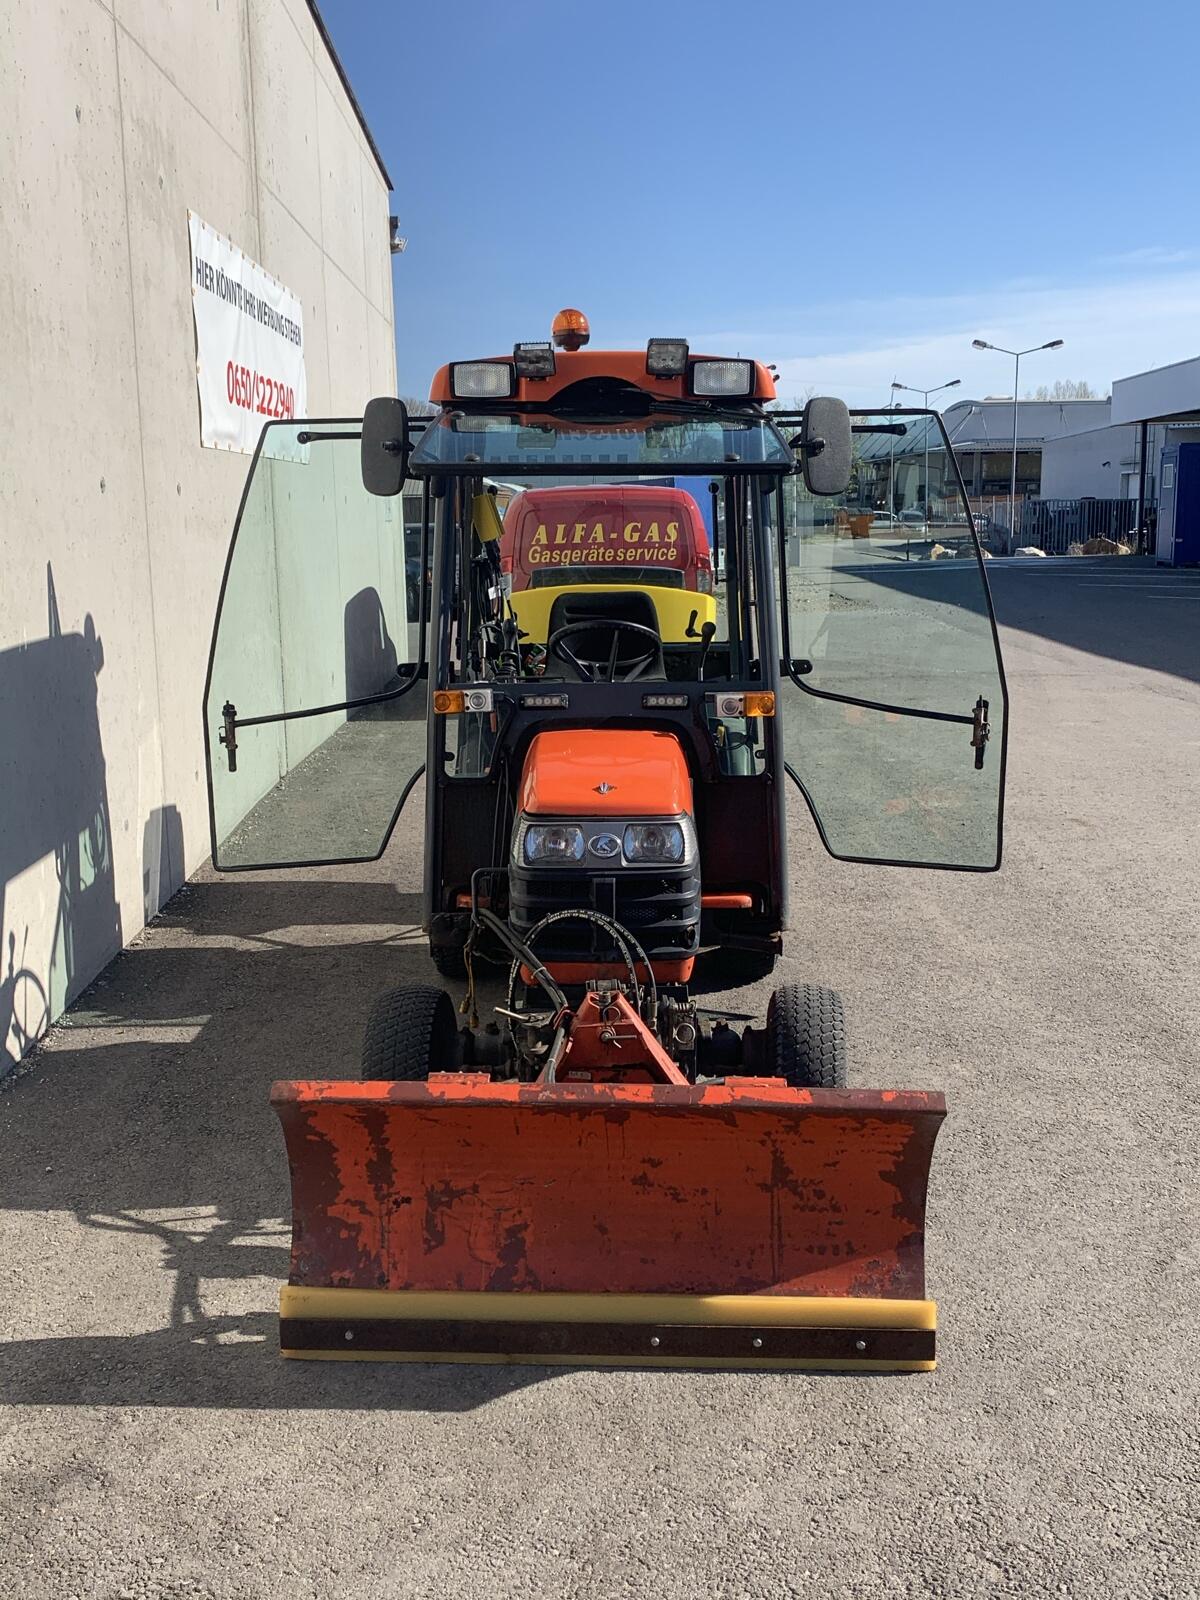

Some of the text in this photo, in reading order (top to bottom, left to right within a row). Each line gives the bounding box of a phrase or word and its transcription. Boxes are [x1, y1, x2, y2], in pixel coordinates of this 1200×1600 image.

[195, 256, 215, 294] HIER
[215, 266, 243, 311] KÖNNTE
[243, 288, 256, 319] IHRE
[256, 298, 285, 337] WERBUNG
[531, 522, 680, 545] ALFA-GAS
[528, 543, 677, 566] Gasgeräteservice
